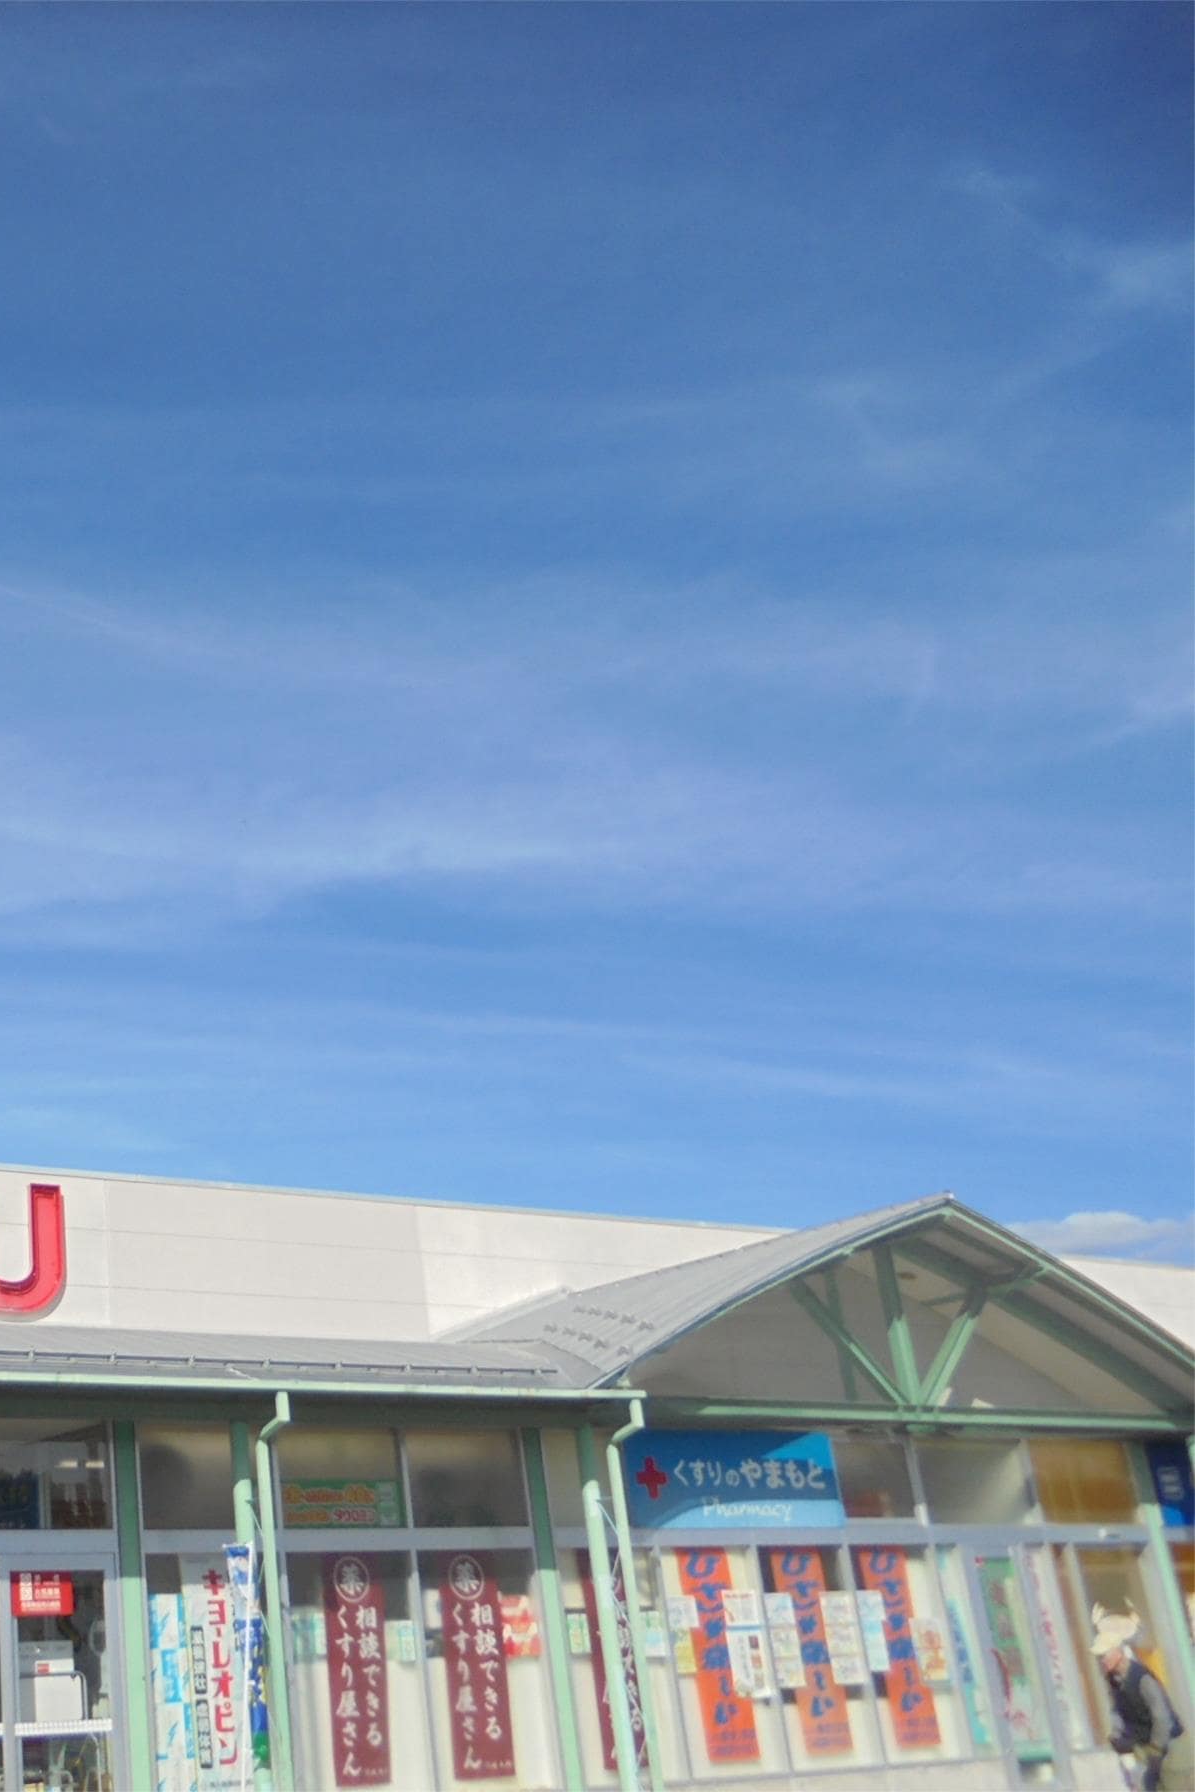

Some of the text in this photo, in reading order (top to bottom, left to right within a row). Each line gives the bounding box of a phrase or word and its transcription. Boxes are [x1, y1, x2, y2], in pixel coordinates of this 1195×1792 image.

[673, 1458, 826, 1489] くすりのやまもと
[702, 1496, 793, 1521] Pharmacy
[335, 1604, 362, 1777] くすり屋さん
[355, 1604, 383, 1747] 相談できる
[452, 1601, 482, 1770] くすり屋さん
[470, 1601, 503, 1740] 相談できる
